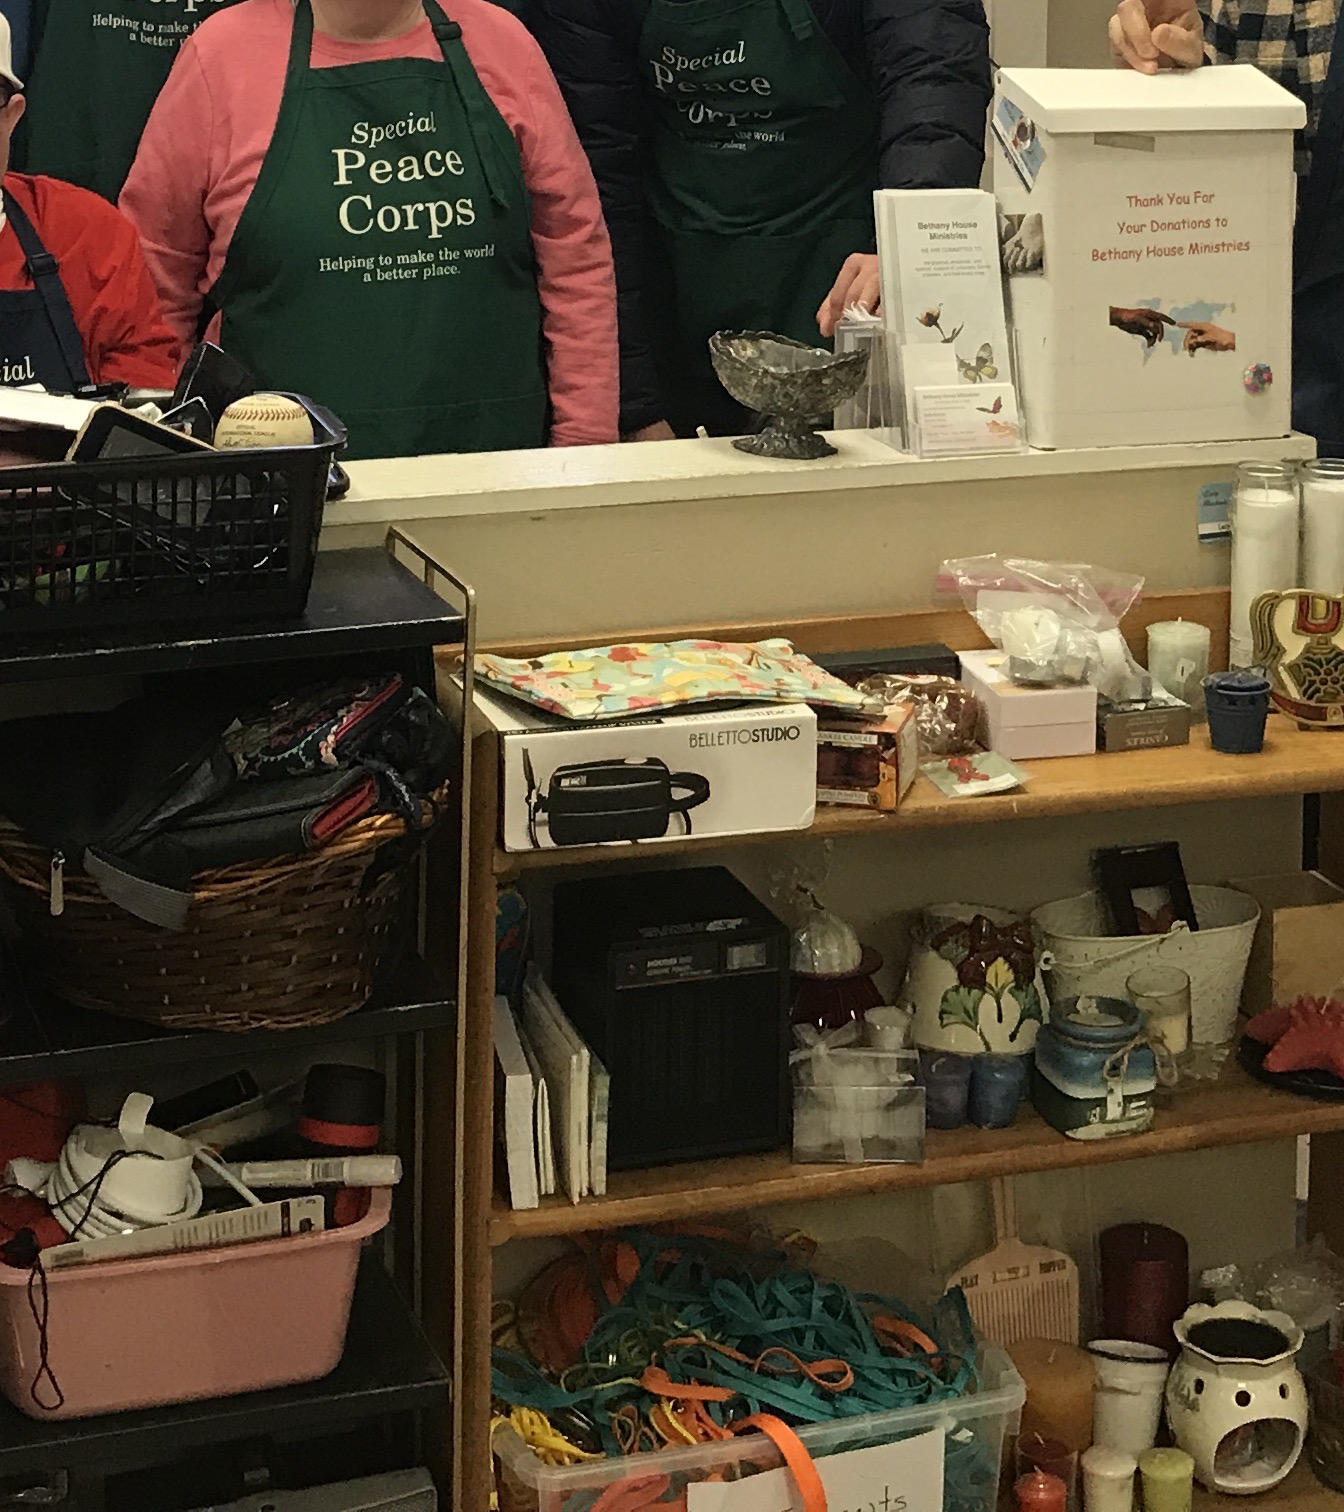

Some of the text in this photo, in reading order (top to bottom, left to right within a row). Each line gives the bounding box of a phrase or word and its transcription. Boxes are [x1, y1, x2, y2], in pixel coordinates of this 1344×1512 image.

[92, 14, 139, 30] Helping
[142, 20, 155, 32] to
[158, 21, 189, 33] make
[129, 33, 137, 41] a
[140, 33, 175, 47] better
[662, 40, 746, 71] Special
[649, 60, 771, 96] Peace
[351, 111, 436, 148] Special
[331, 148, 465, 185] Peace
[1126, 191, 1215, 208] Thank You For
[338, 195, 476, 238] Corps
[917, 221, 978, 231] Bethany House
[1117, 217, 1228, 234] Your Donations to
[929, 232, 968, 240] Ministries
[319, 244, 495, 272] Helping to make the world
[1091, 240, 1251, 263] Bethany House Ministries
[363, 264, 461, 282] a better place.
[688, 724, 801, 749] BELLETTOSTUDIO
[817, 732, 843, 741] ANKEE
